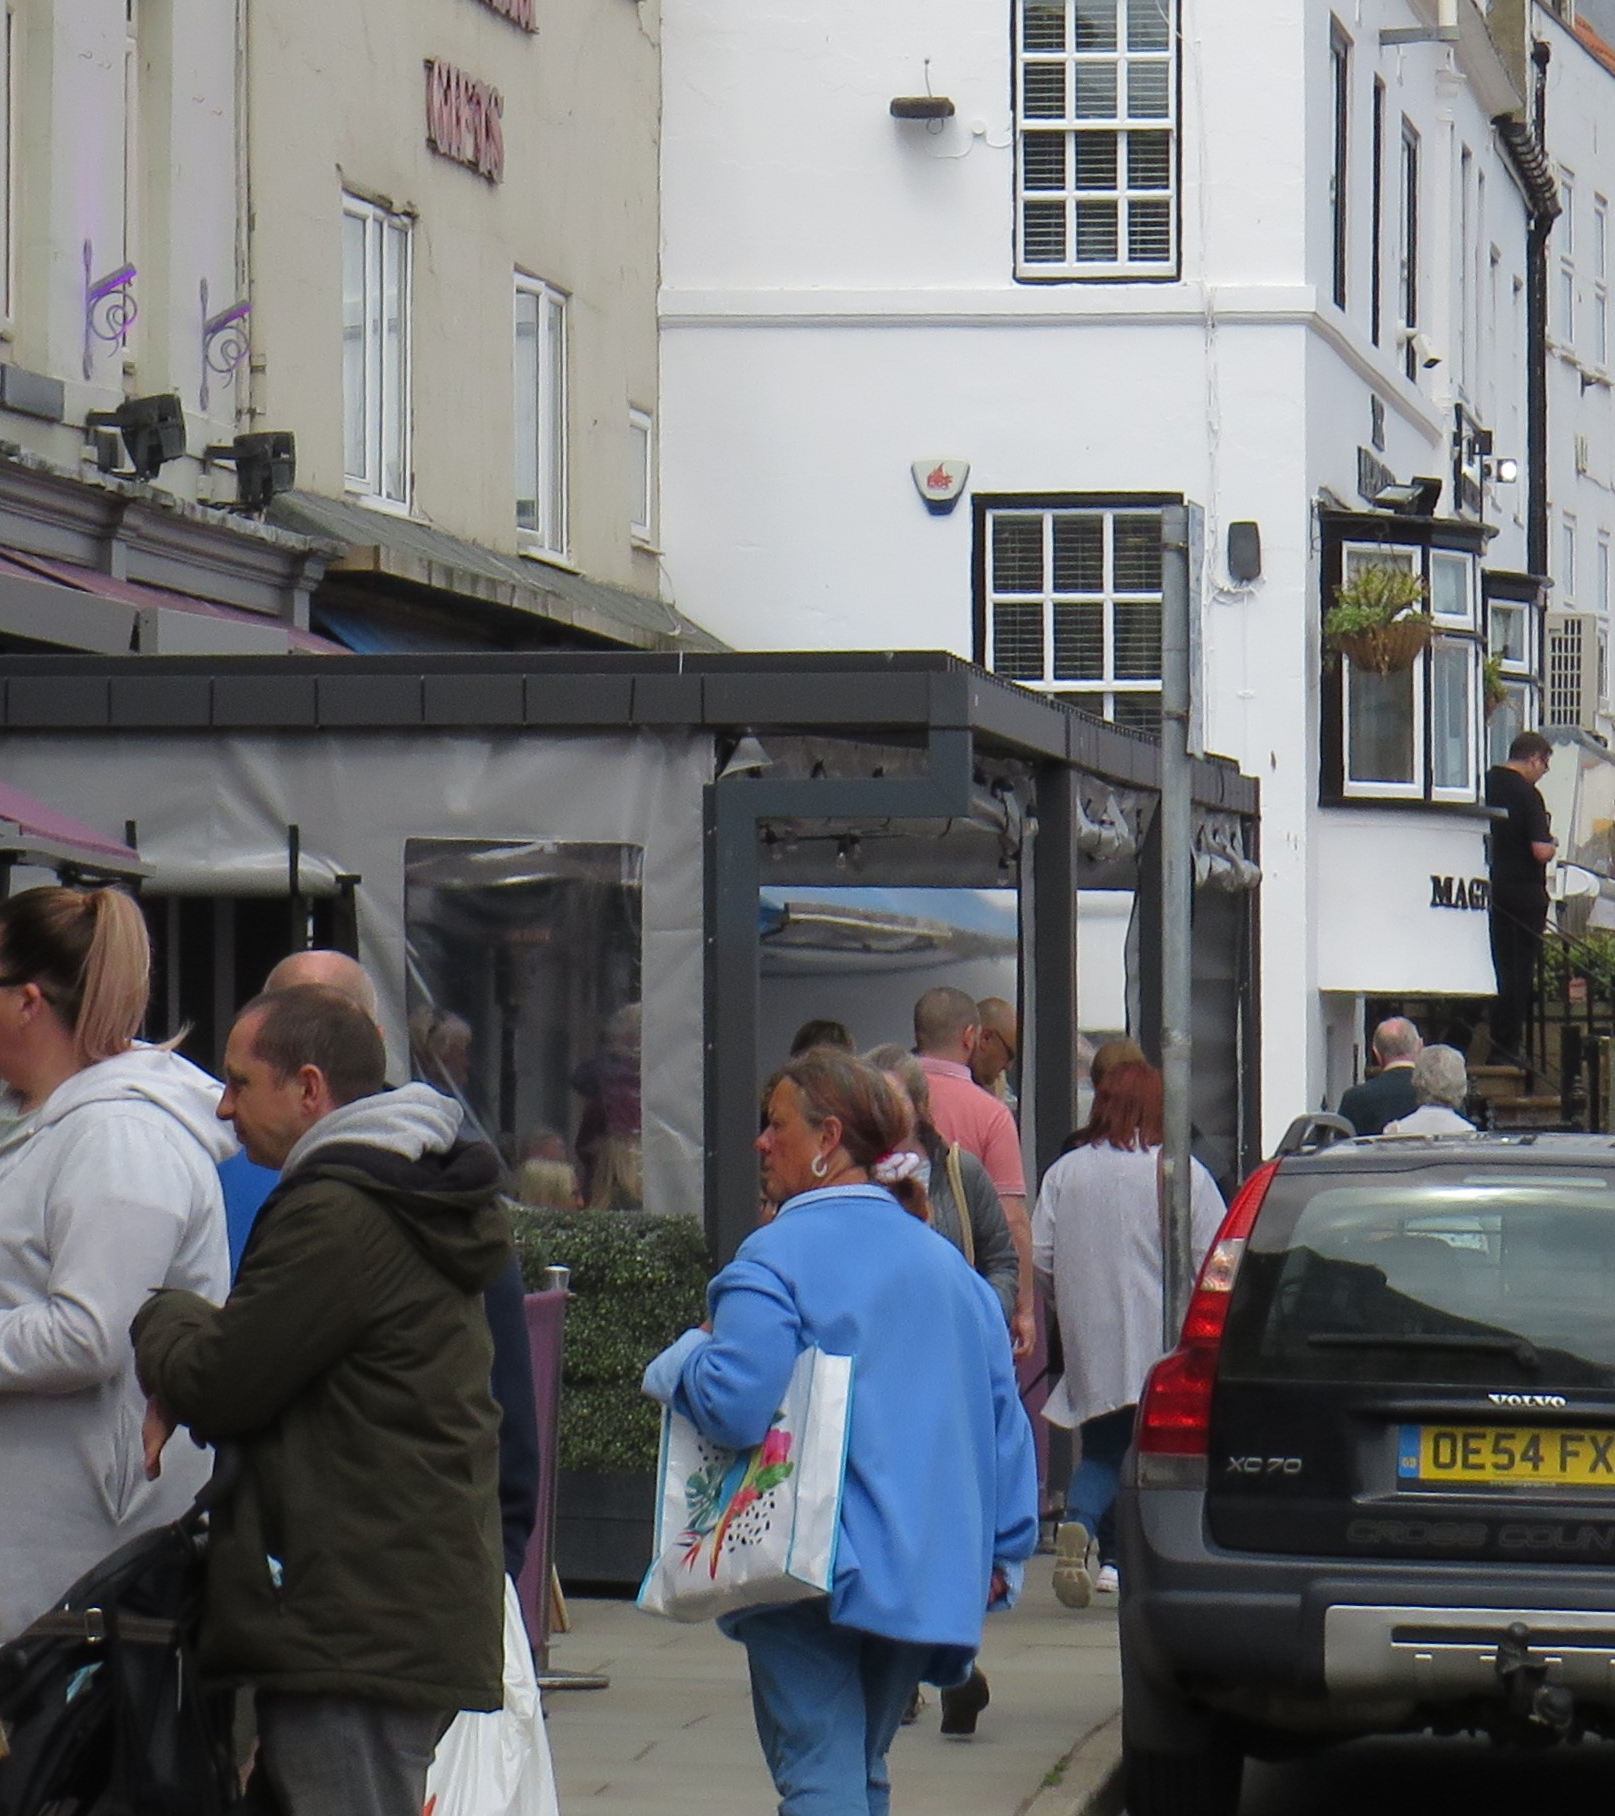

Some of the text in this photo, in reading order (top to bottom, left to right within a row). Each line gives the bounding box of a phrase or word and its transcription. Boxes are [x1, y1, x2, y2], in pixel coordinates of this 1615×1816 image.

[1430, 874, 1492, 910] MAG
[1487, 1393, 1567, 1408] VOLVO
[1432, 1432, 1544, 1472] OE54
[1266, 1457, 1302, 1474] 70
